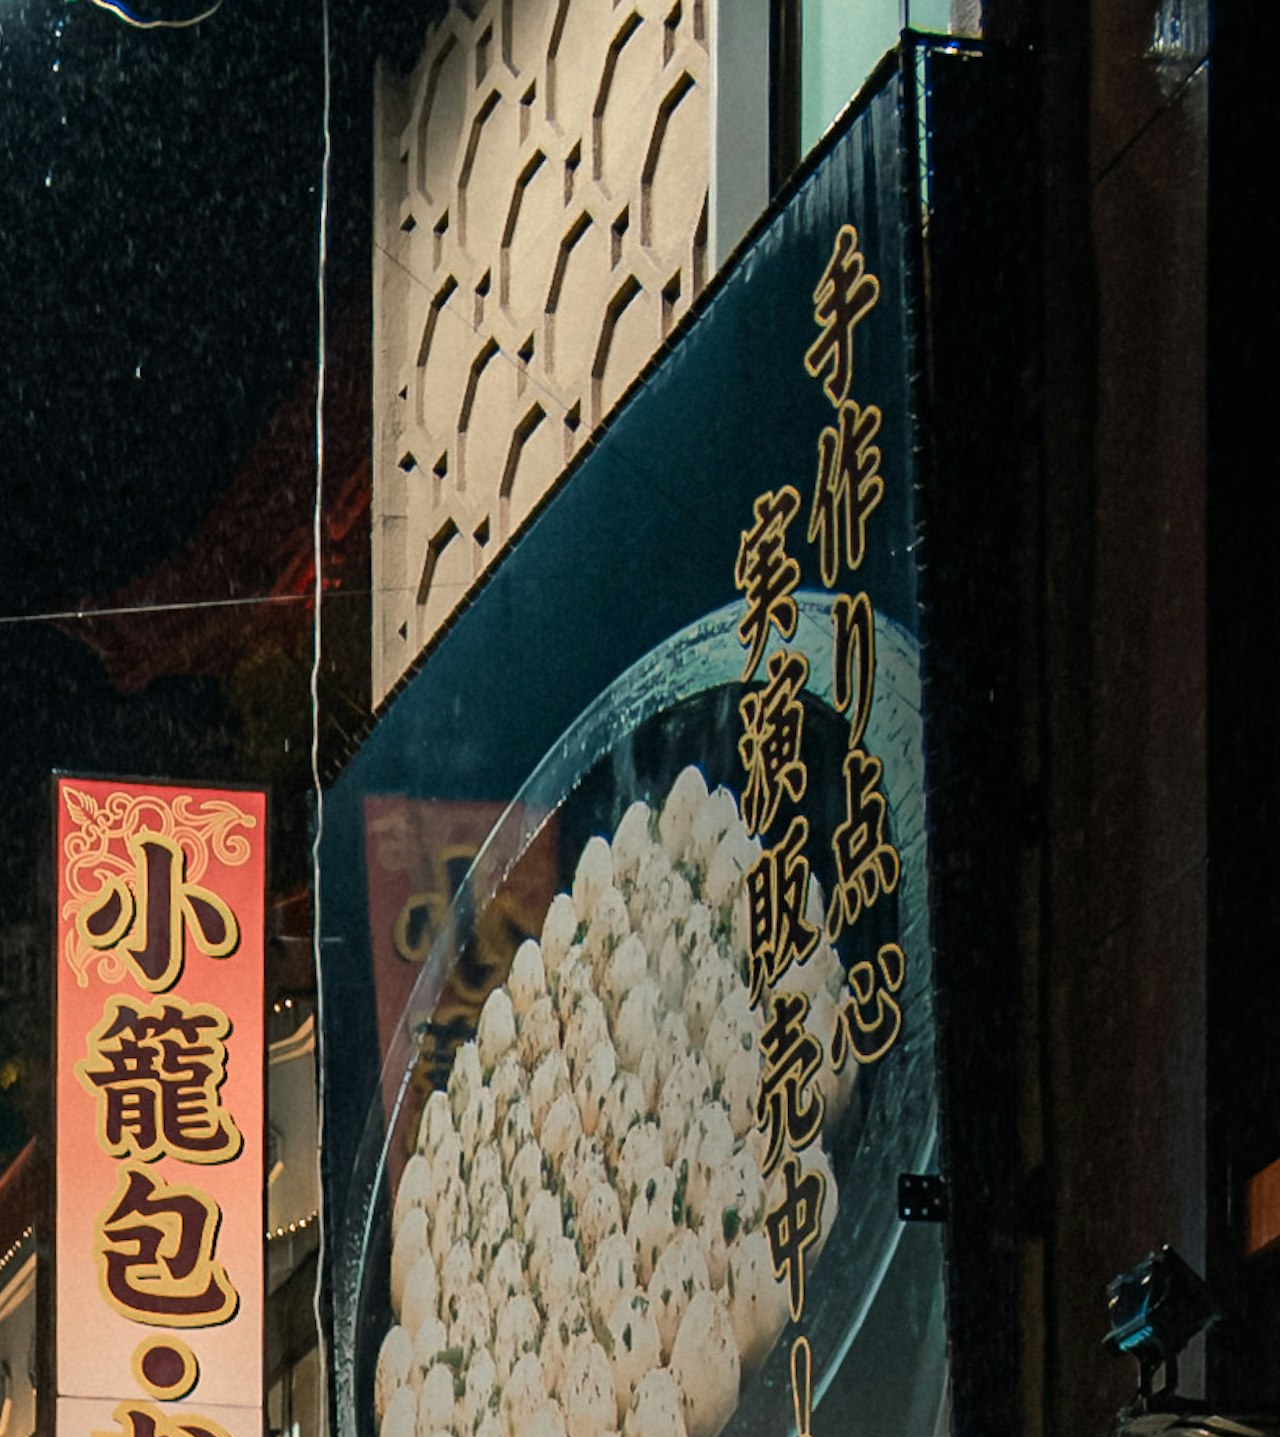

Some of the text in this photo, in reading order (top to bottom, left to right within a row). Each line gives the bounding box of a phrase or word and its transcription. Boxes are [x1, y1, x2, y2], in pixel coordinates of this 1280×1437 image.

[804, 224, 904, 1072] 手作り点心
